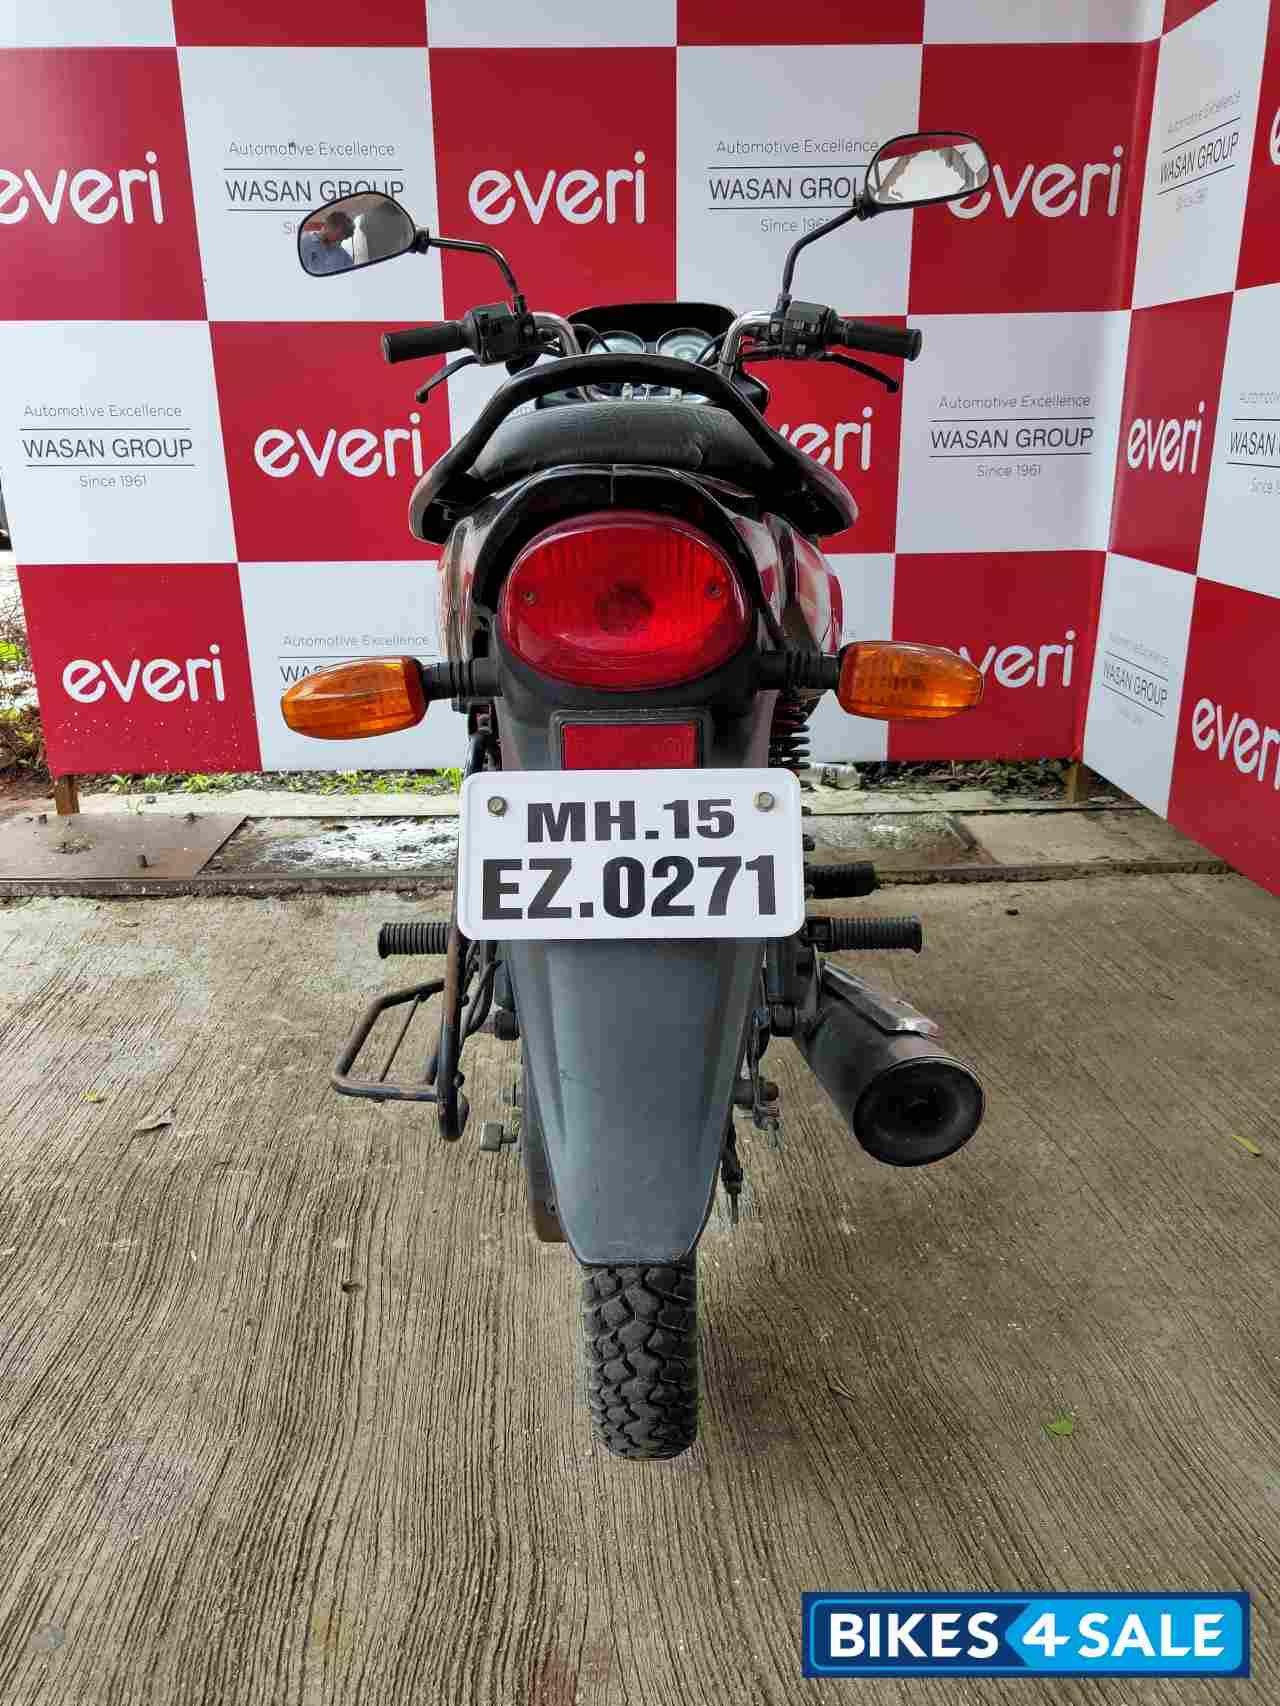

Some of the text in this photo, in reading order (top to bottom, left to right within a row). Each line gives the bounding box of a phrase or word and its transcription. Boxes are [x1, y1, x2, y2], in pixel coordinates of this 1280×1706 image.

[229, 141, 394, 156] Automotive Excellence
[716, 139, 879, 154] Automotive Excellence
[225, 180, 312, 202] WASAN
[469, 152, 646, 225] everi
[709, 178, 791, 200] WASAN
[760, 218, 799, 232] Since
[24, 404, 182, 417] Automotive Excellence
[939, 394, 1090, 409] Automotive Excellence
[22, 438, 193, 458] WASAN GROUP
[254, 413, 423, 478] everi
[930, 428, 1094, 449] WASAN GROUP
[1128, 402, 1205, 474] everi
[1230, 431, 1276, 457] WASAN
[79, 474, 147, 488] Since 1961
[977, 464, 1041, 477] Since 1961
[63, 644, 224, 703] everi
[527, 799, 735, 843] MH.15
[482, 855, 777, 921] EZ.0271
